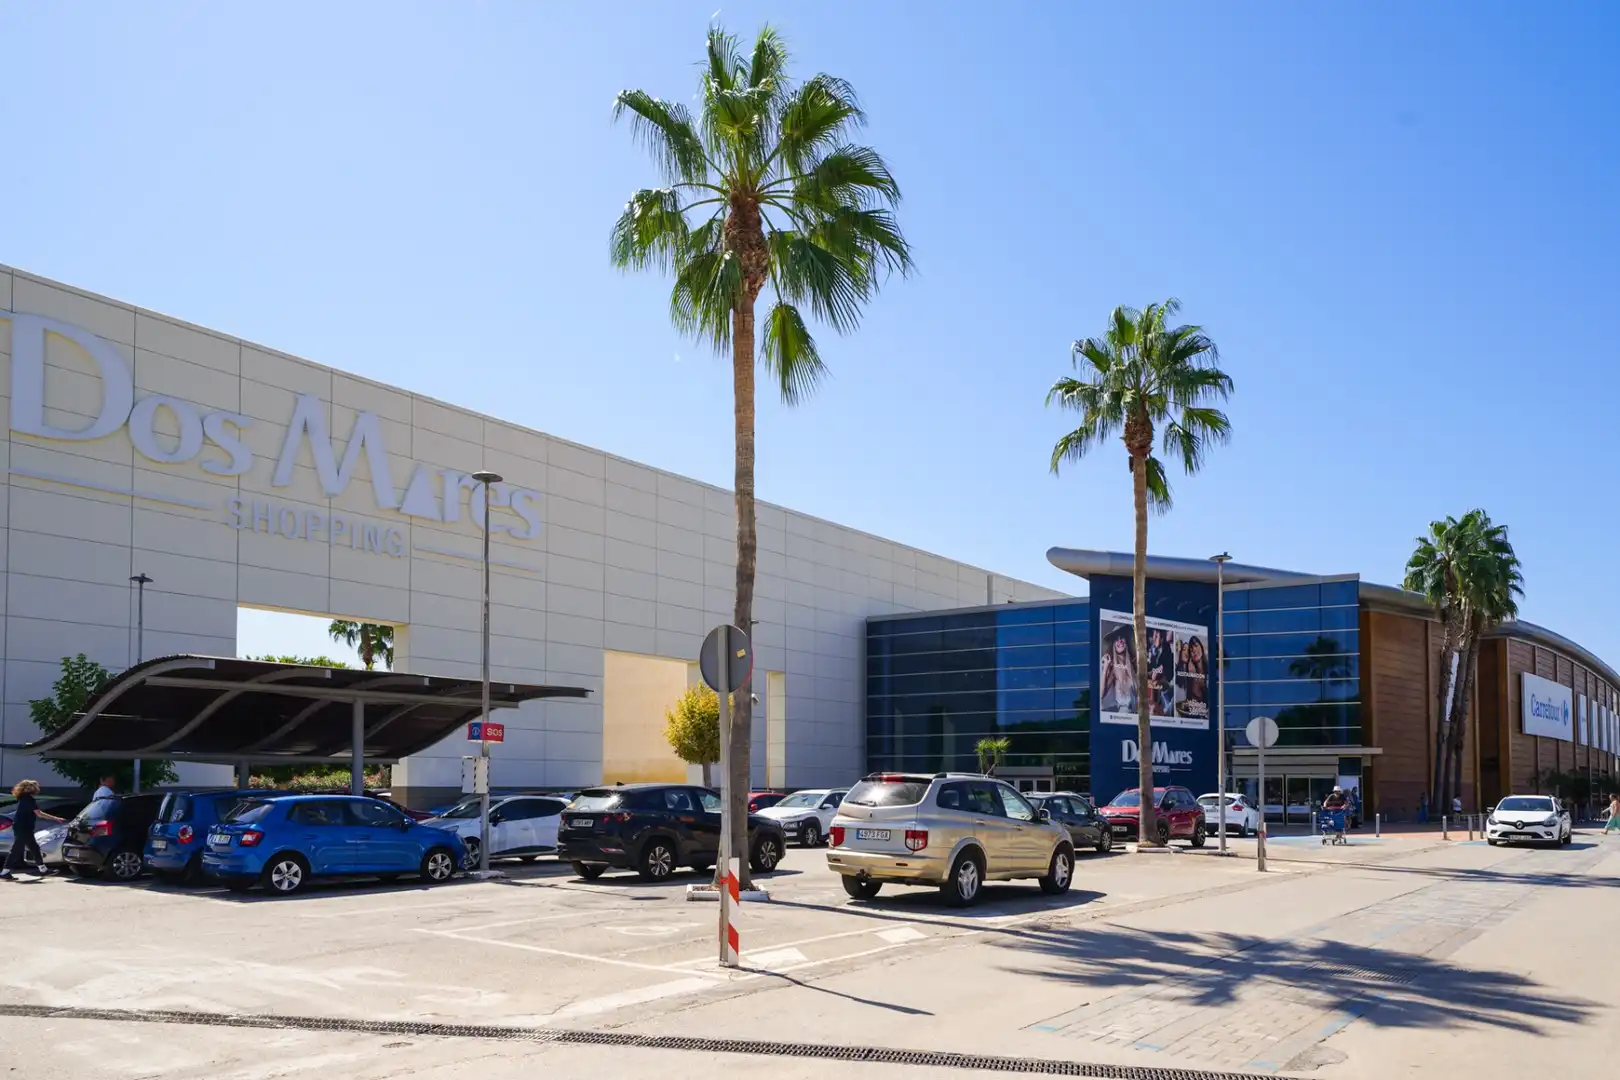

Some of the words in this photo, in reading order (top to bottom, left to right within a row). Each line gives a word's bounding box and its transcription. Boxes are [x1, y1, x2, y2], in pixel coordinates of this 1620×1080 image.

[0, 312, 254, 477] Dos
[271, 392, 543, 540] Mares
[223, 495, 405, 558] SHOPPING
[1531, 693, 1560, 721] Carrefour
[487, 728, 503, 736] SOS
